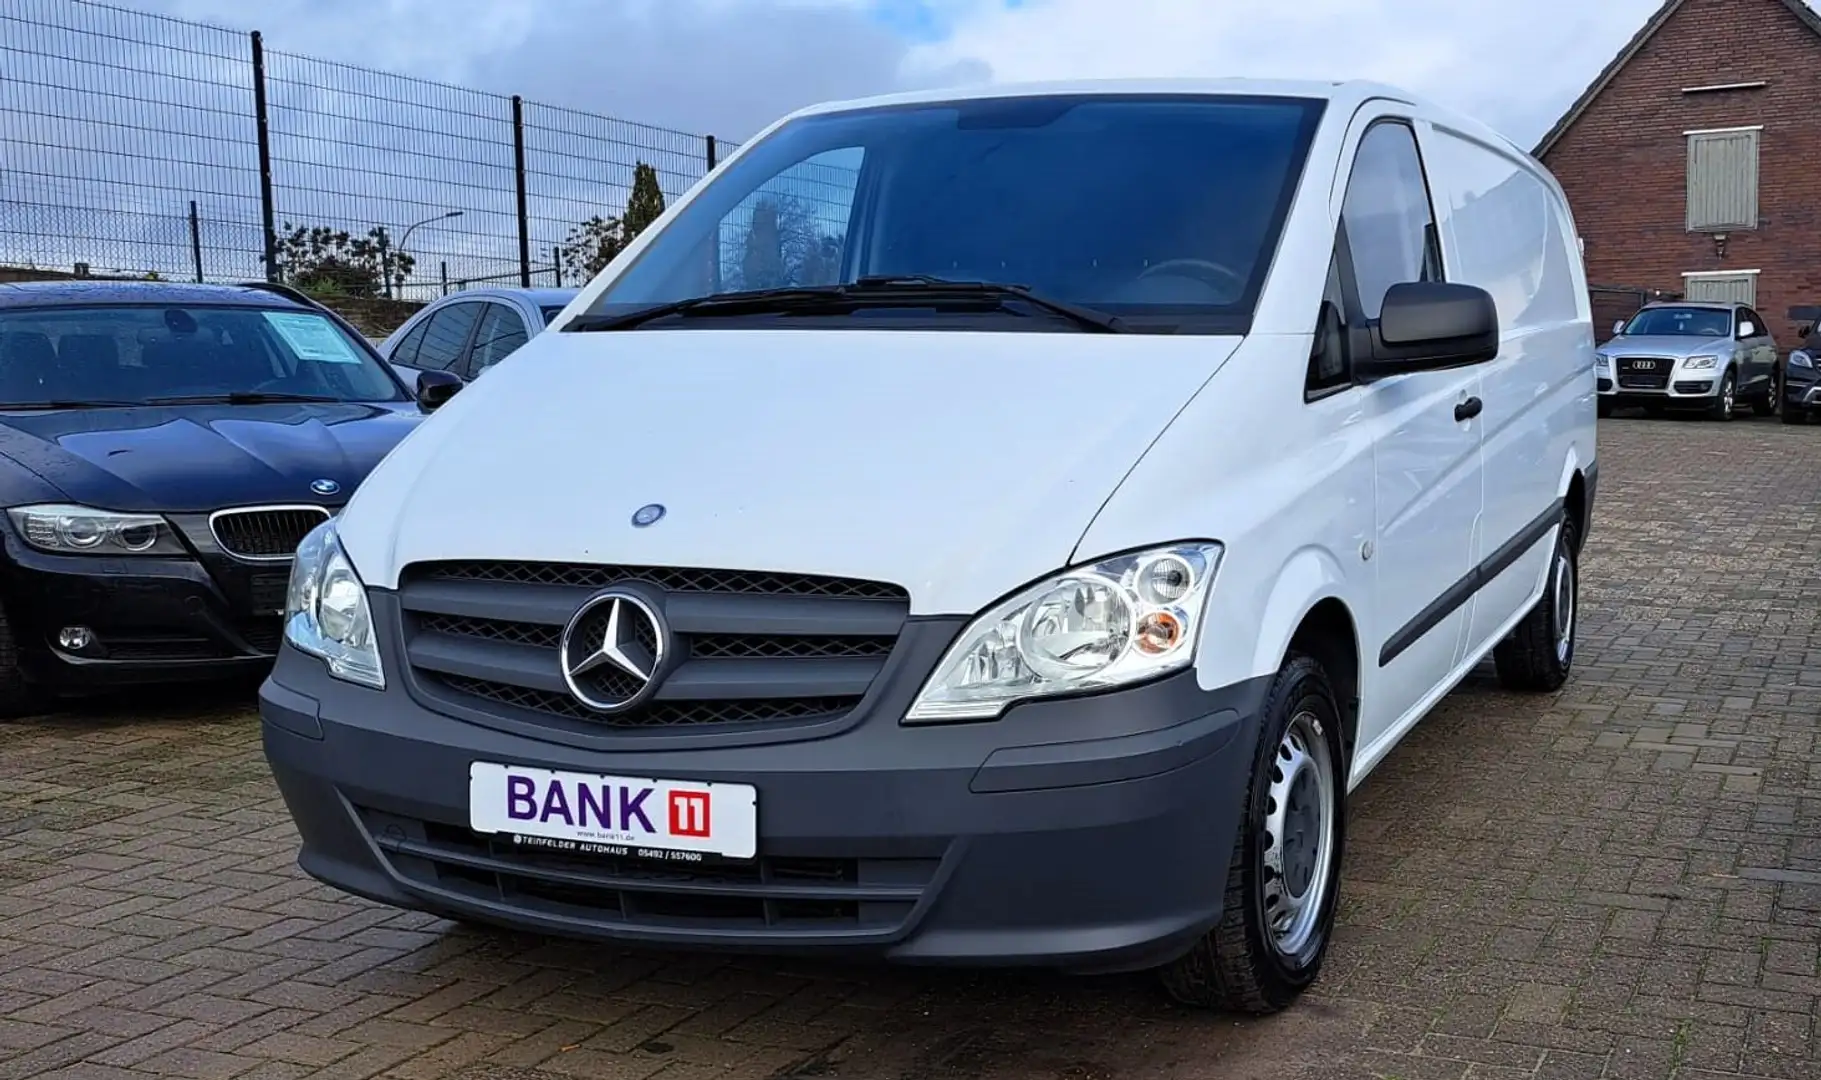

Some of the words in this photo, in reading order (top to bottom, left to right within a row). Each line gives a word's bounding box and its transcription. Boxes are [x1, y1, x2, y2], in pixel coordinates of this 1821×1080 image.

[507, 775, 657, 834] BANK
[674, 796, 704, 831] 11
[579, 843, 628, 856] AUTOHAUS
[665, 850, 670, 860] /
